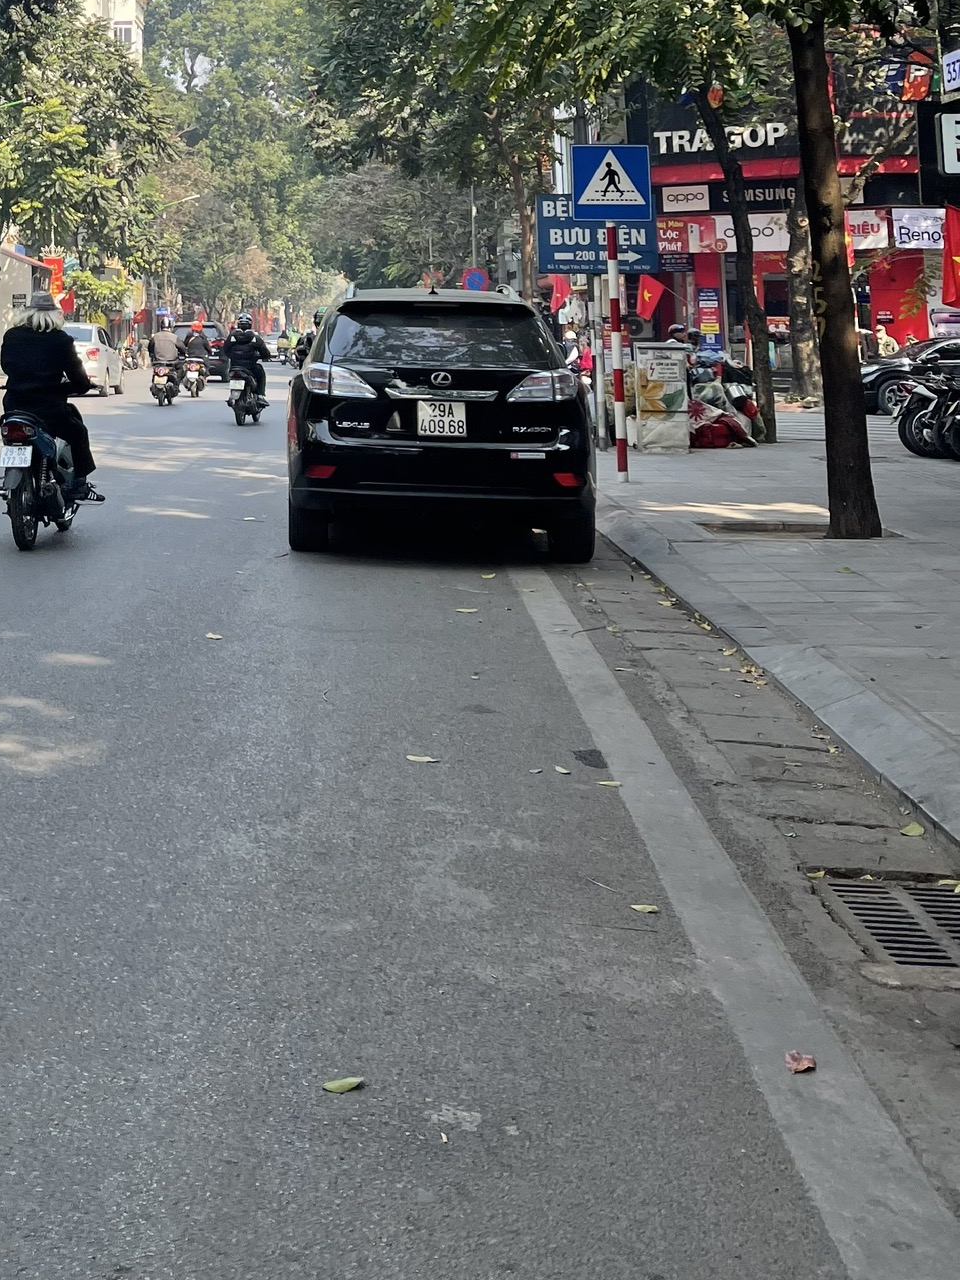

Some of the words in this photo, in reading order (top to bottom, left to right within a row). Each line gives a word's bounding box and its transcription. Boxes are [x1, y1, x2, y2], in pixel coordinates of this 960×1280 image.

[722, 187, 796, 203] SMSUNG
[549, 227, 591, 246] BƯU
[597, 225, 647, 249] ĐỆN
[660, 229, 680, 240] Lộc
[575, 251, 596, 261] 200
[429, 403, 454, 418] 29A
[420, 419, 465, 434] 409.68
